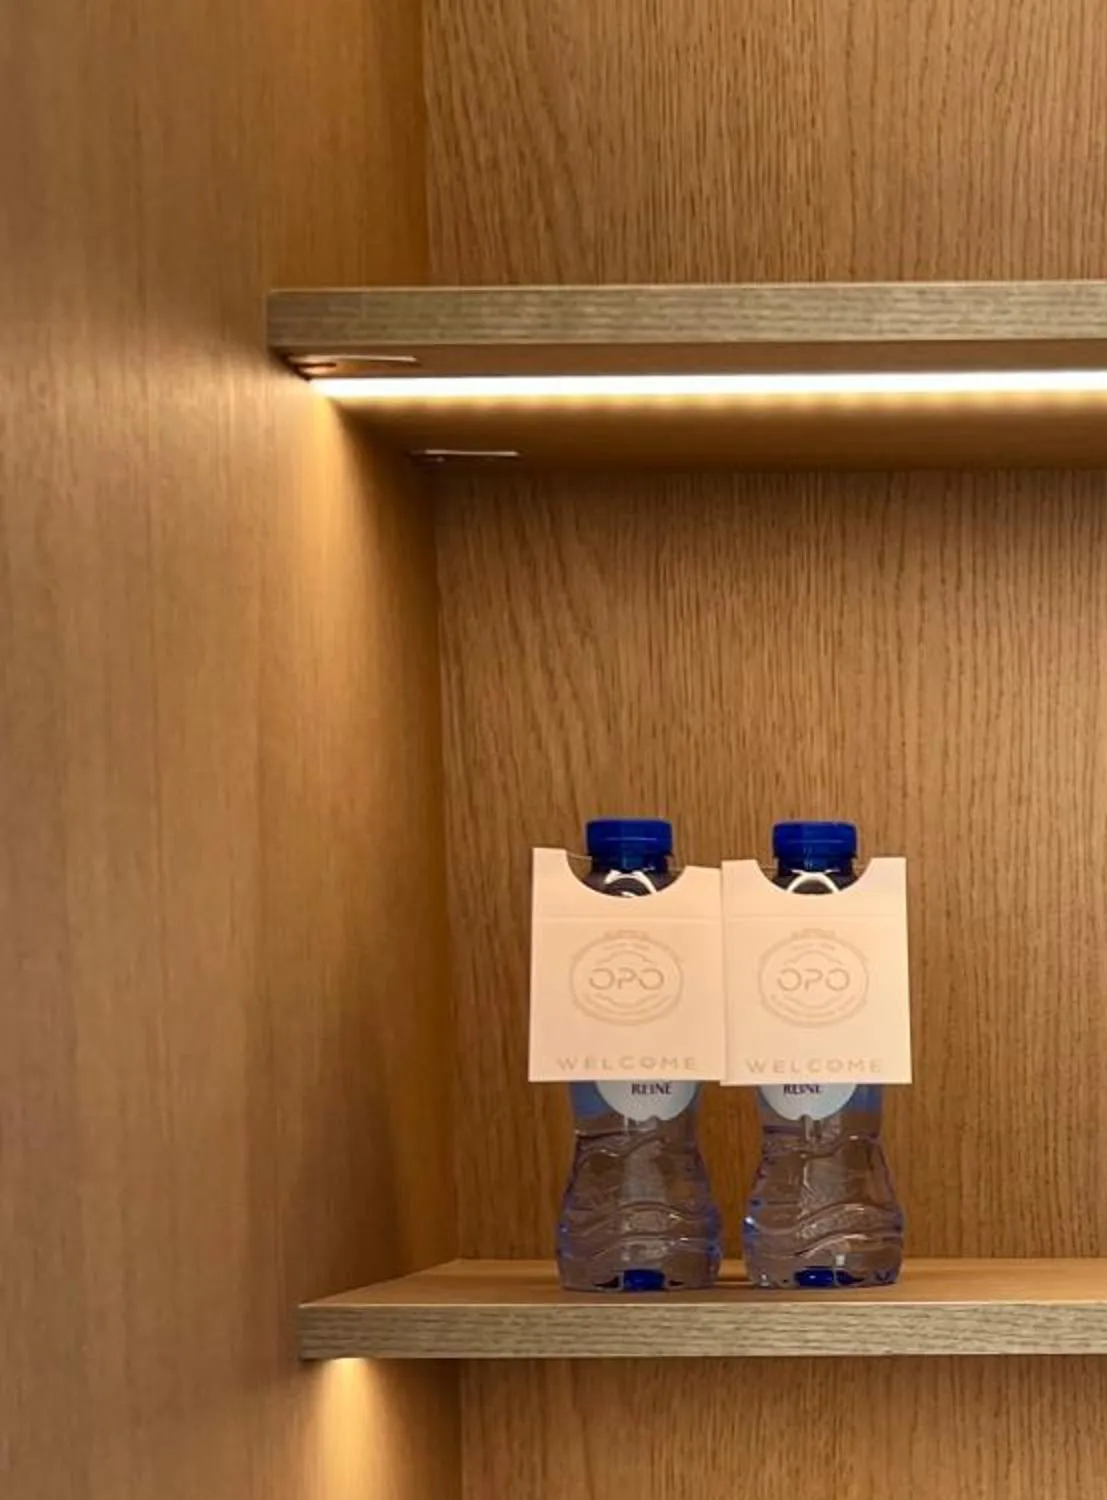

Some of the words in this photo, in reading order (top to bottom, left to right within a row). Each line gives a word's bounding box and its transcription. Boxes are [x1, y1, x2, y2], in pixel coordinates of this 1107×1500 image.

[588, 968, 665, 990] OPO
[777, 968, 850, 991] OPO
[556, 1056, 697, 1071] WELCOME
[746, 1058, 882, 1074] WELCOME
